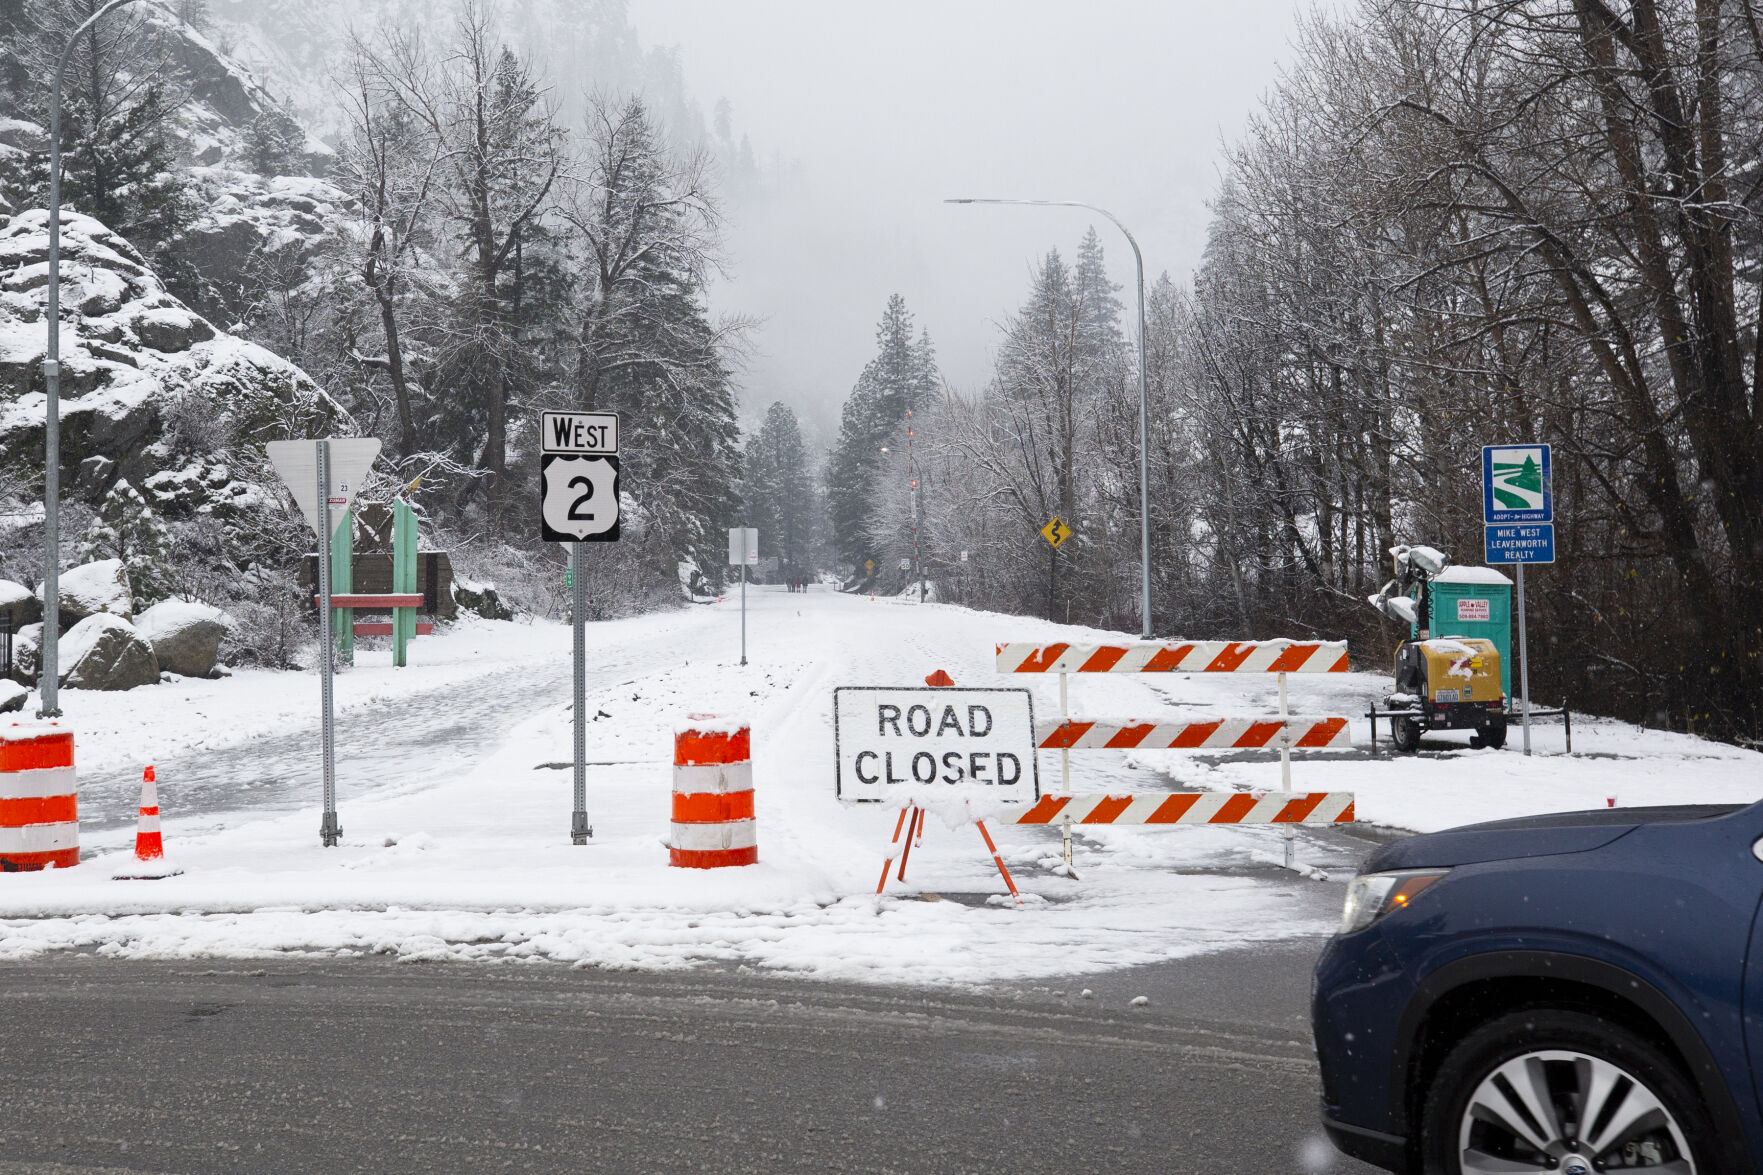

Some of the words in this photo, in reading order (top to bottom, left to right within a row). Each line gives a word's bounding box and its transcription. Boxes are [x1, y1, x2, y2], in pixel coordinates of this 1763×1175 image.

[552, 416, 608, 448] WEST
[567, 475, 595, 521] 2
[1491, 539, 1548, 549] LEAVENWORTH
[1497, 529, 1516, 538] MIKE
[1520, 528, 1540, 537] WEST
[1505, 550, 1534, 559] REALTY
[878, 704, 993, 738] ROAD
[855, 751, 1022, 785] CLOSED
